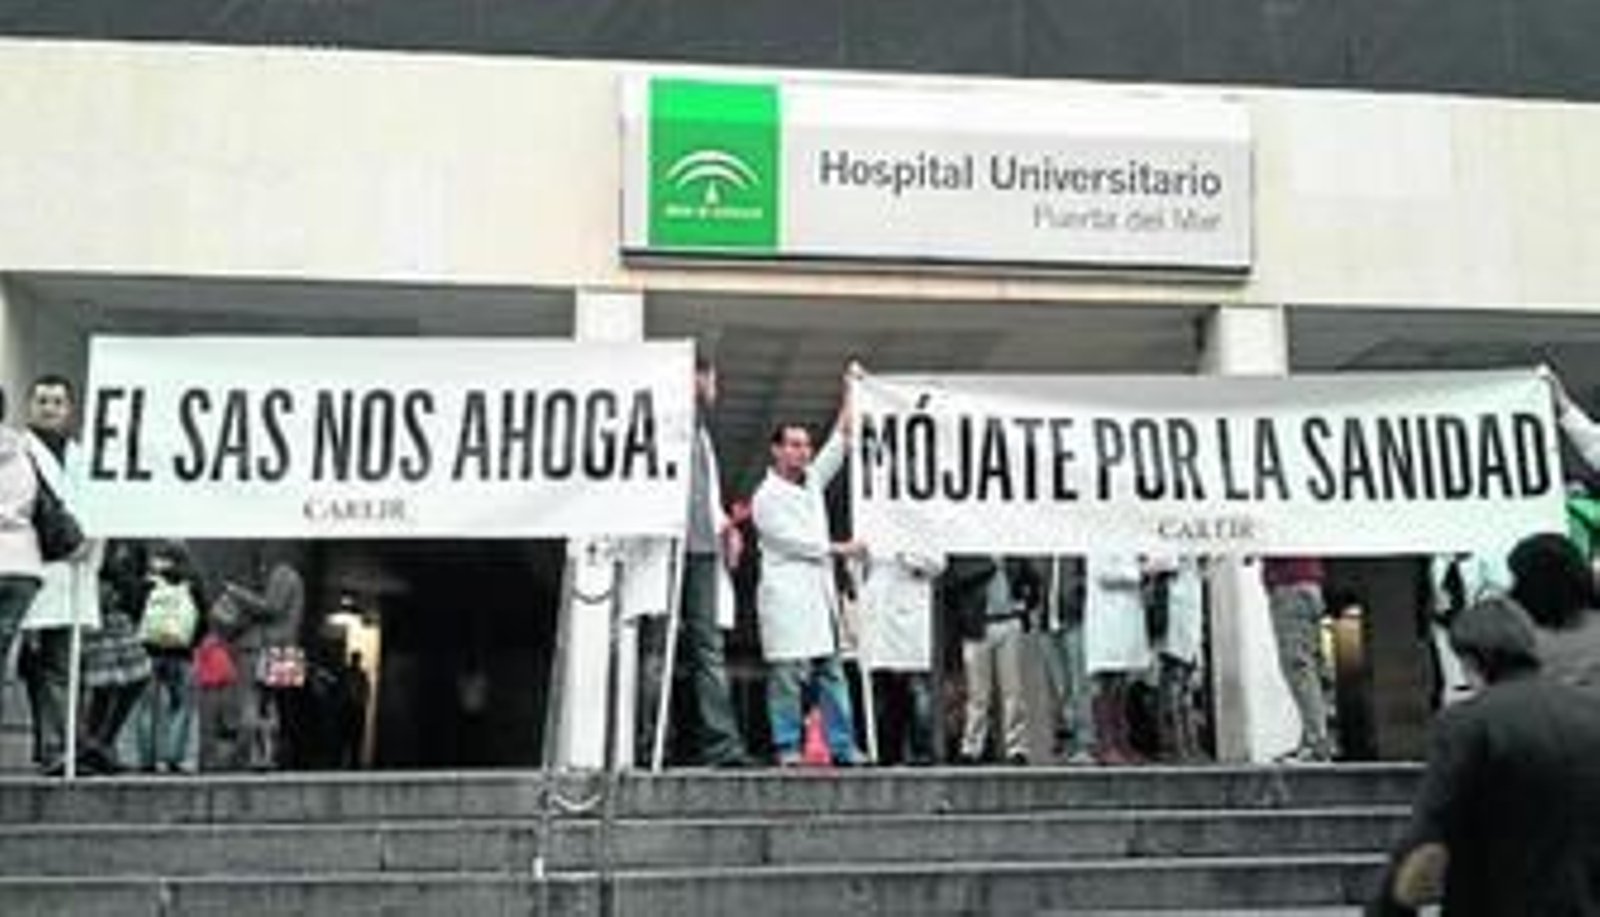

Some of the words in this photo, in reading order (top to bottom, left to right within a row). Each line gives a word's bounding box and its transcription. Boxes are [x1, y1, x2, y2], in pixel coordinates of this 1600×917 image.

[819, 148, 974, 197] Hospital
[990, 156, 1222, 200] Universitario
[1033, 204, 1117, 229] Puerta
[1125, 203, 1164, 231] del
[90, 388, 155, 482] EL
[173, 388, 293, 482] SAS
[311, 388, 434, 482] NOS
[452, 388, 679, 482] AHOGA.
[861, 394, 1077, 501] MÓJATE
[1094, 417, 1202, 502] POR
[1217, 416, 1291, 502] LA
[1304, 413, 1553, 501] SANIDAD
